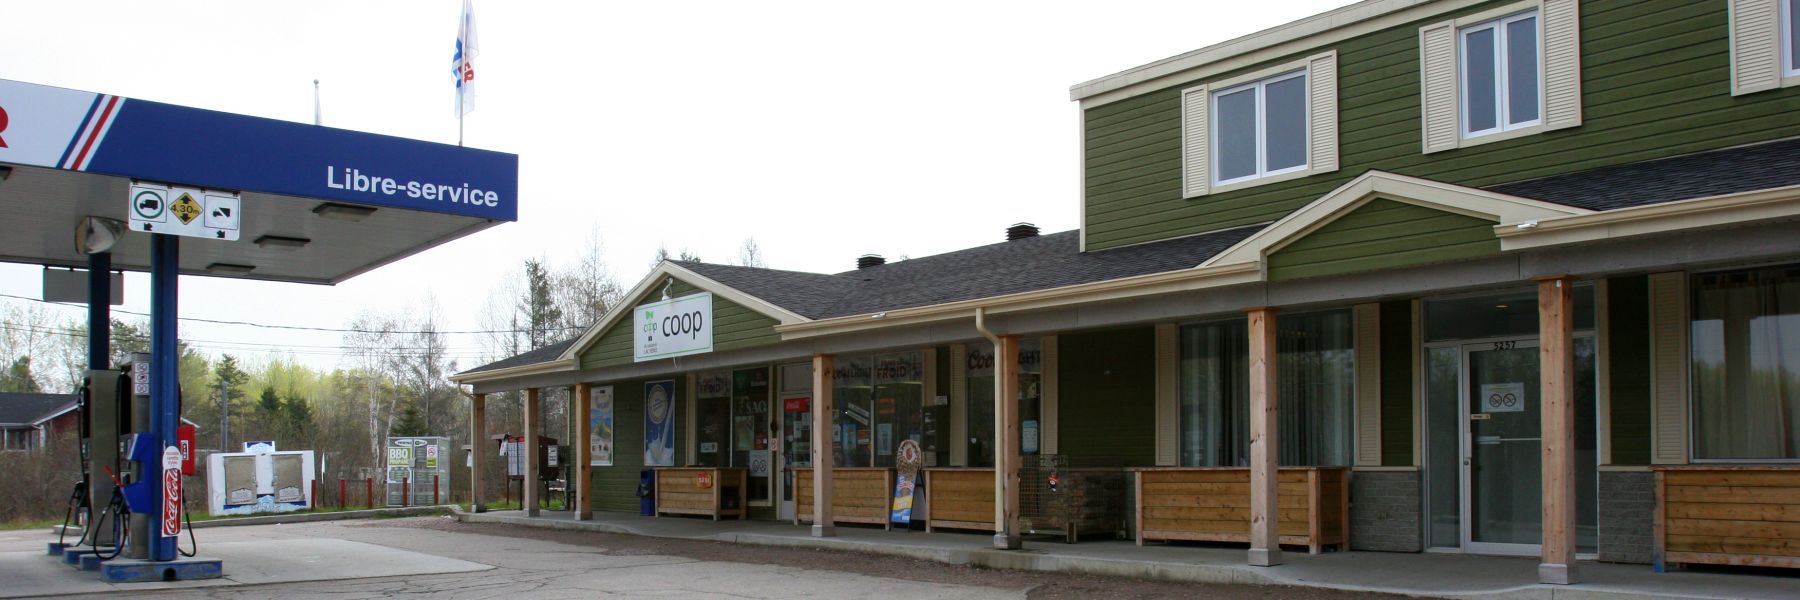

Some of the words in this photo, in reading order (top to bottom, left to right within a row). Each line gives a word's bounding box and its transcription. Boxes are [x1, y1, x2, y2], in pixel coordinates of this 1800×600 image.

[327, 165, 499, 207] Libre-service
[662, 310, 703, 340] coop
[1494, 341, 1516, 351] 5257
[968, 350, 994, 369] Coo
[1018, 351, 1040, 365] GHT
[389, 448, 408, 459] BBQ
